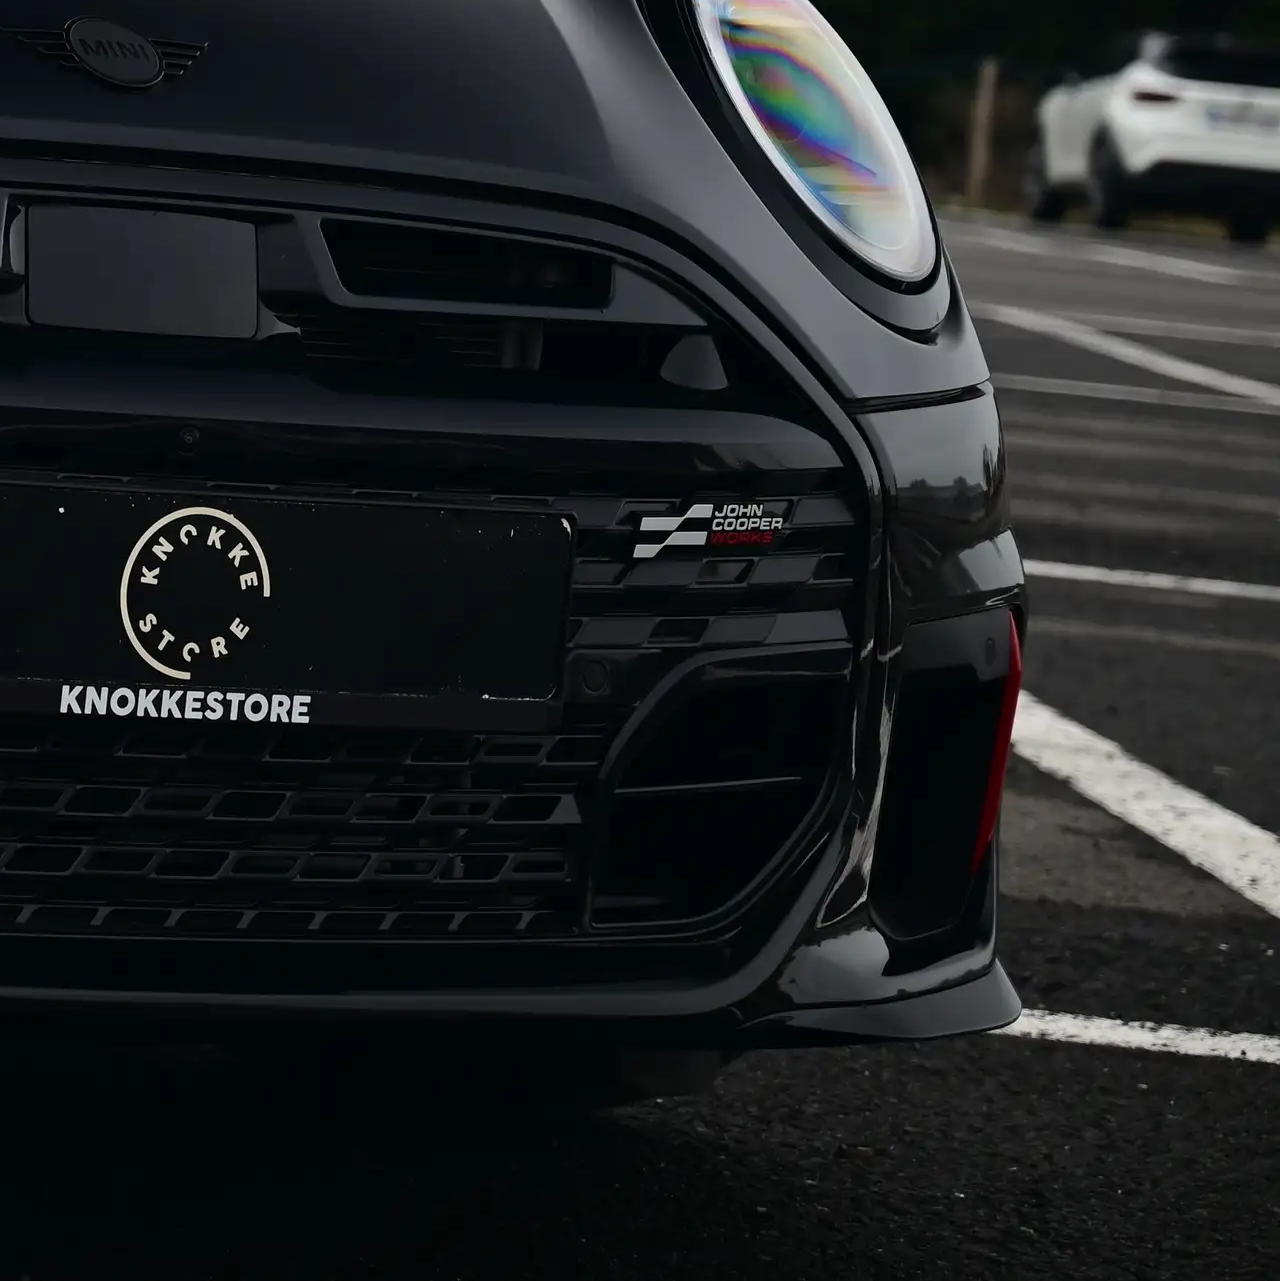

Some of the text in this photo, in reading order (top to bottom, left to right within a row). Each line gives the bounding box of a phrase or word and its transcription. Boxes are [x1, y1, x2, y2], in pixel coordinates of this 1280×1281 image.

[78, 38, 151, 62] MINI
[714, 503, 764, 518] JOHN
[711, 517, 784, 531] COOPER
[709, 531, 774, 545] WORKS
[59, 684, 312, 724] KNOKKESTORE
